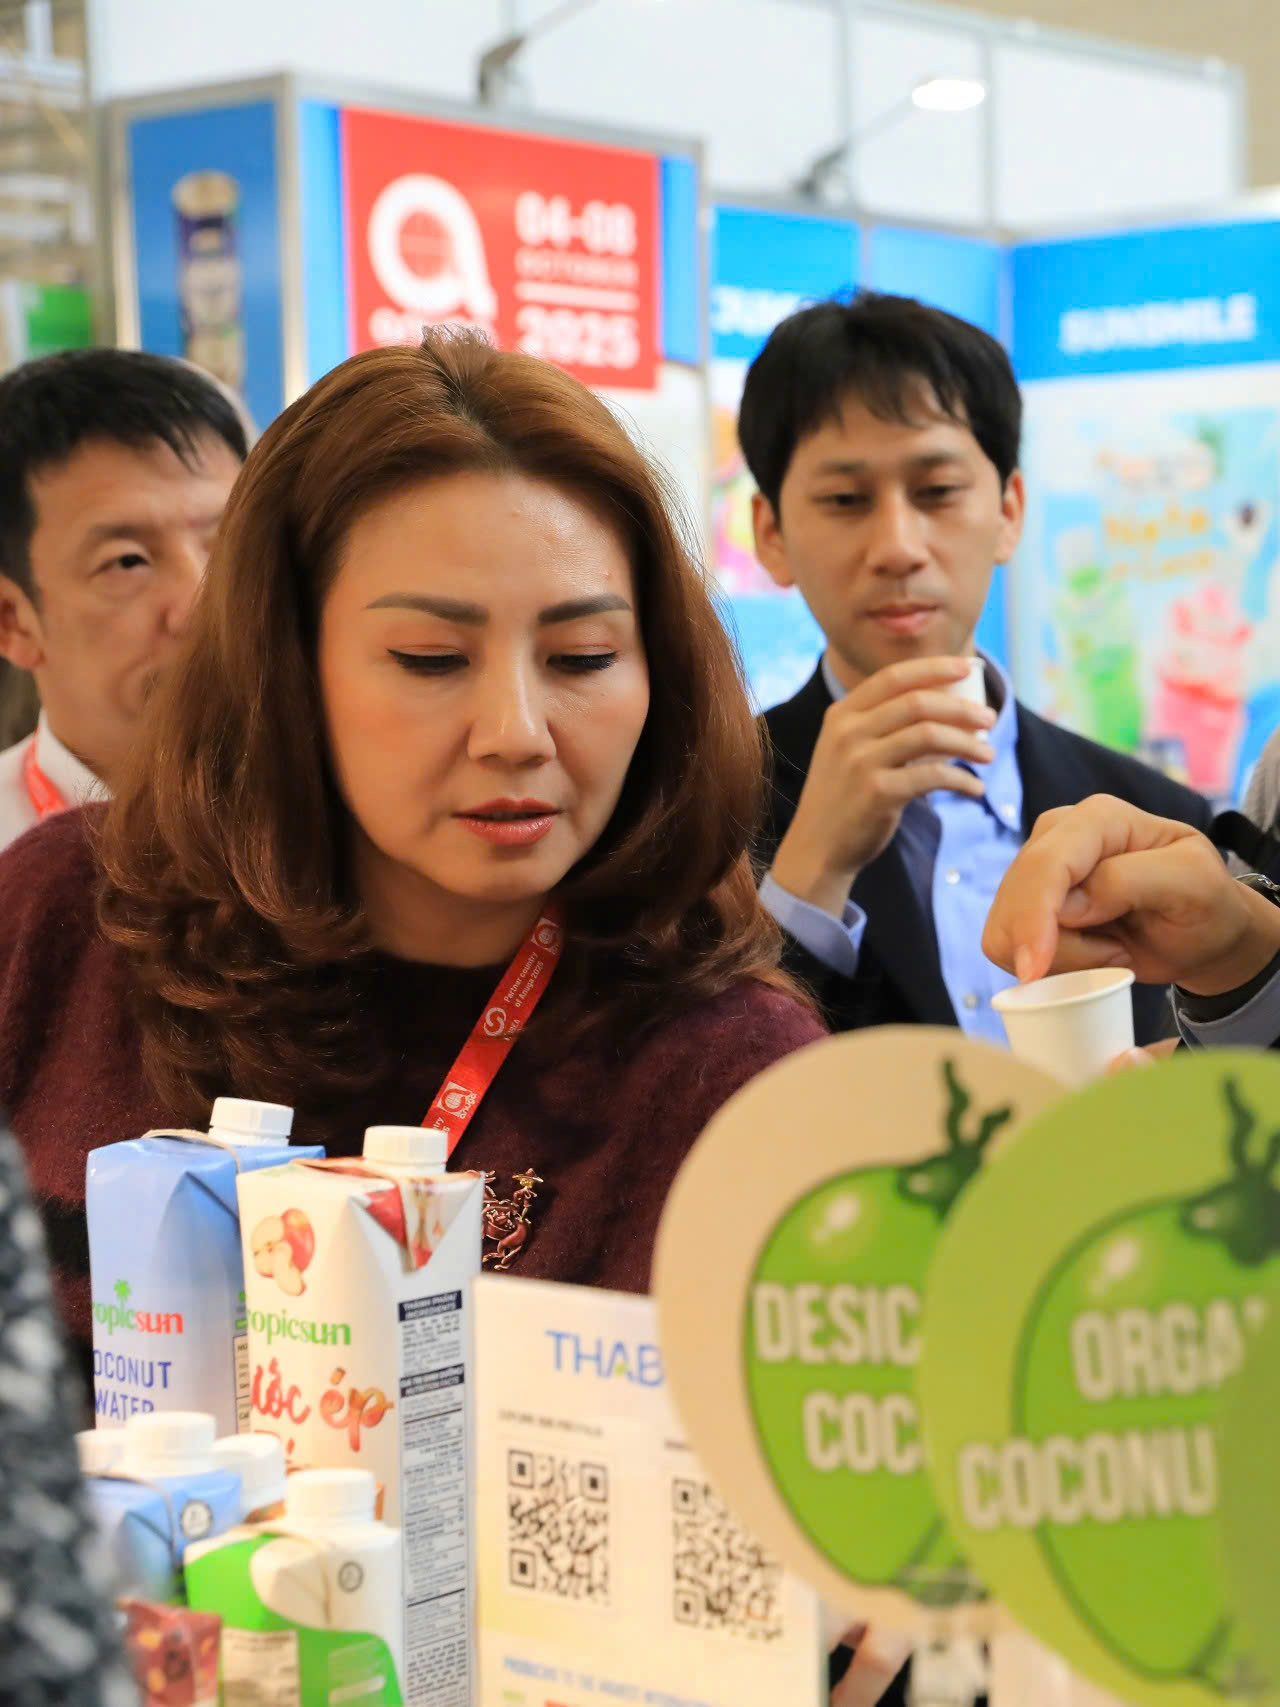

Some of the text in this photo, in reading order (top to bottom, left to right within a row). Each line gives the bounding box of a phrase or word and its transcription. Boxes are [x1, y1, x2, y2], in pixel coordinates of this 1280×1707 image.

[515, 304, 639, 370] 2025
[504, 952, 538, 1002] Partner country
[515, 961, 544, 1007] of Anuga 2025
[93, 1301, 184, 1336] opicsun
[248, 1309, 352, 1346] opicsun
[545, 1330, 665, 1387] THAB
[1070, 1300, 1266, 1401] ORGA
